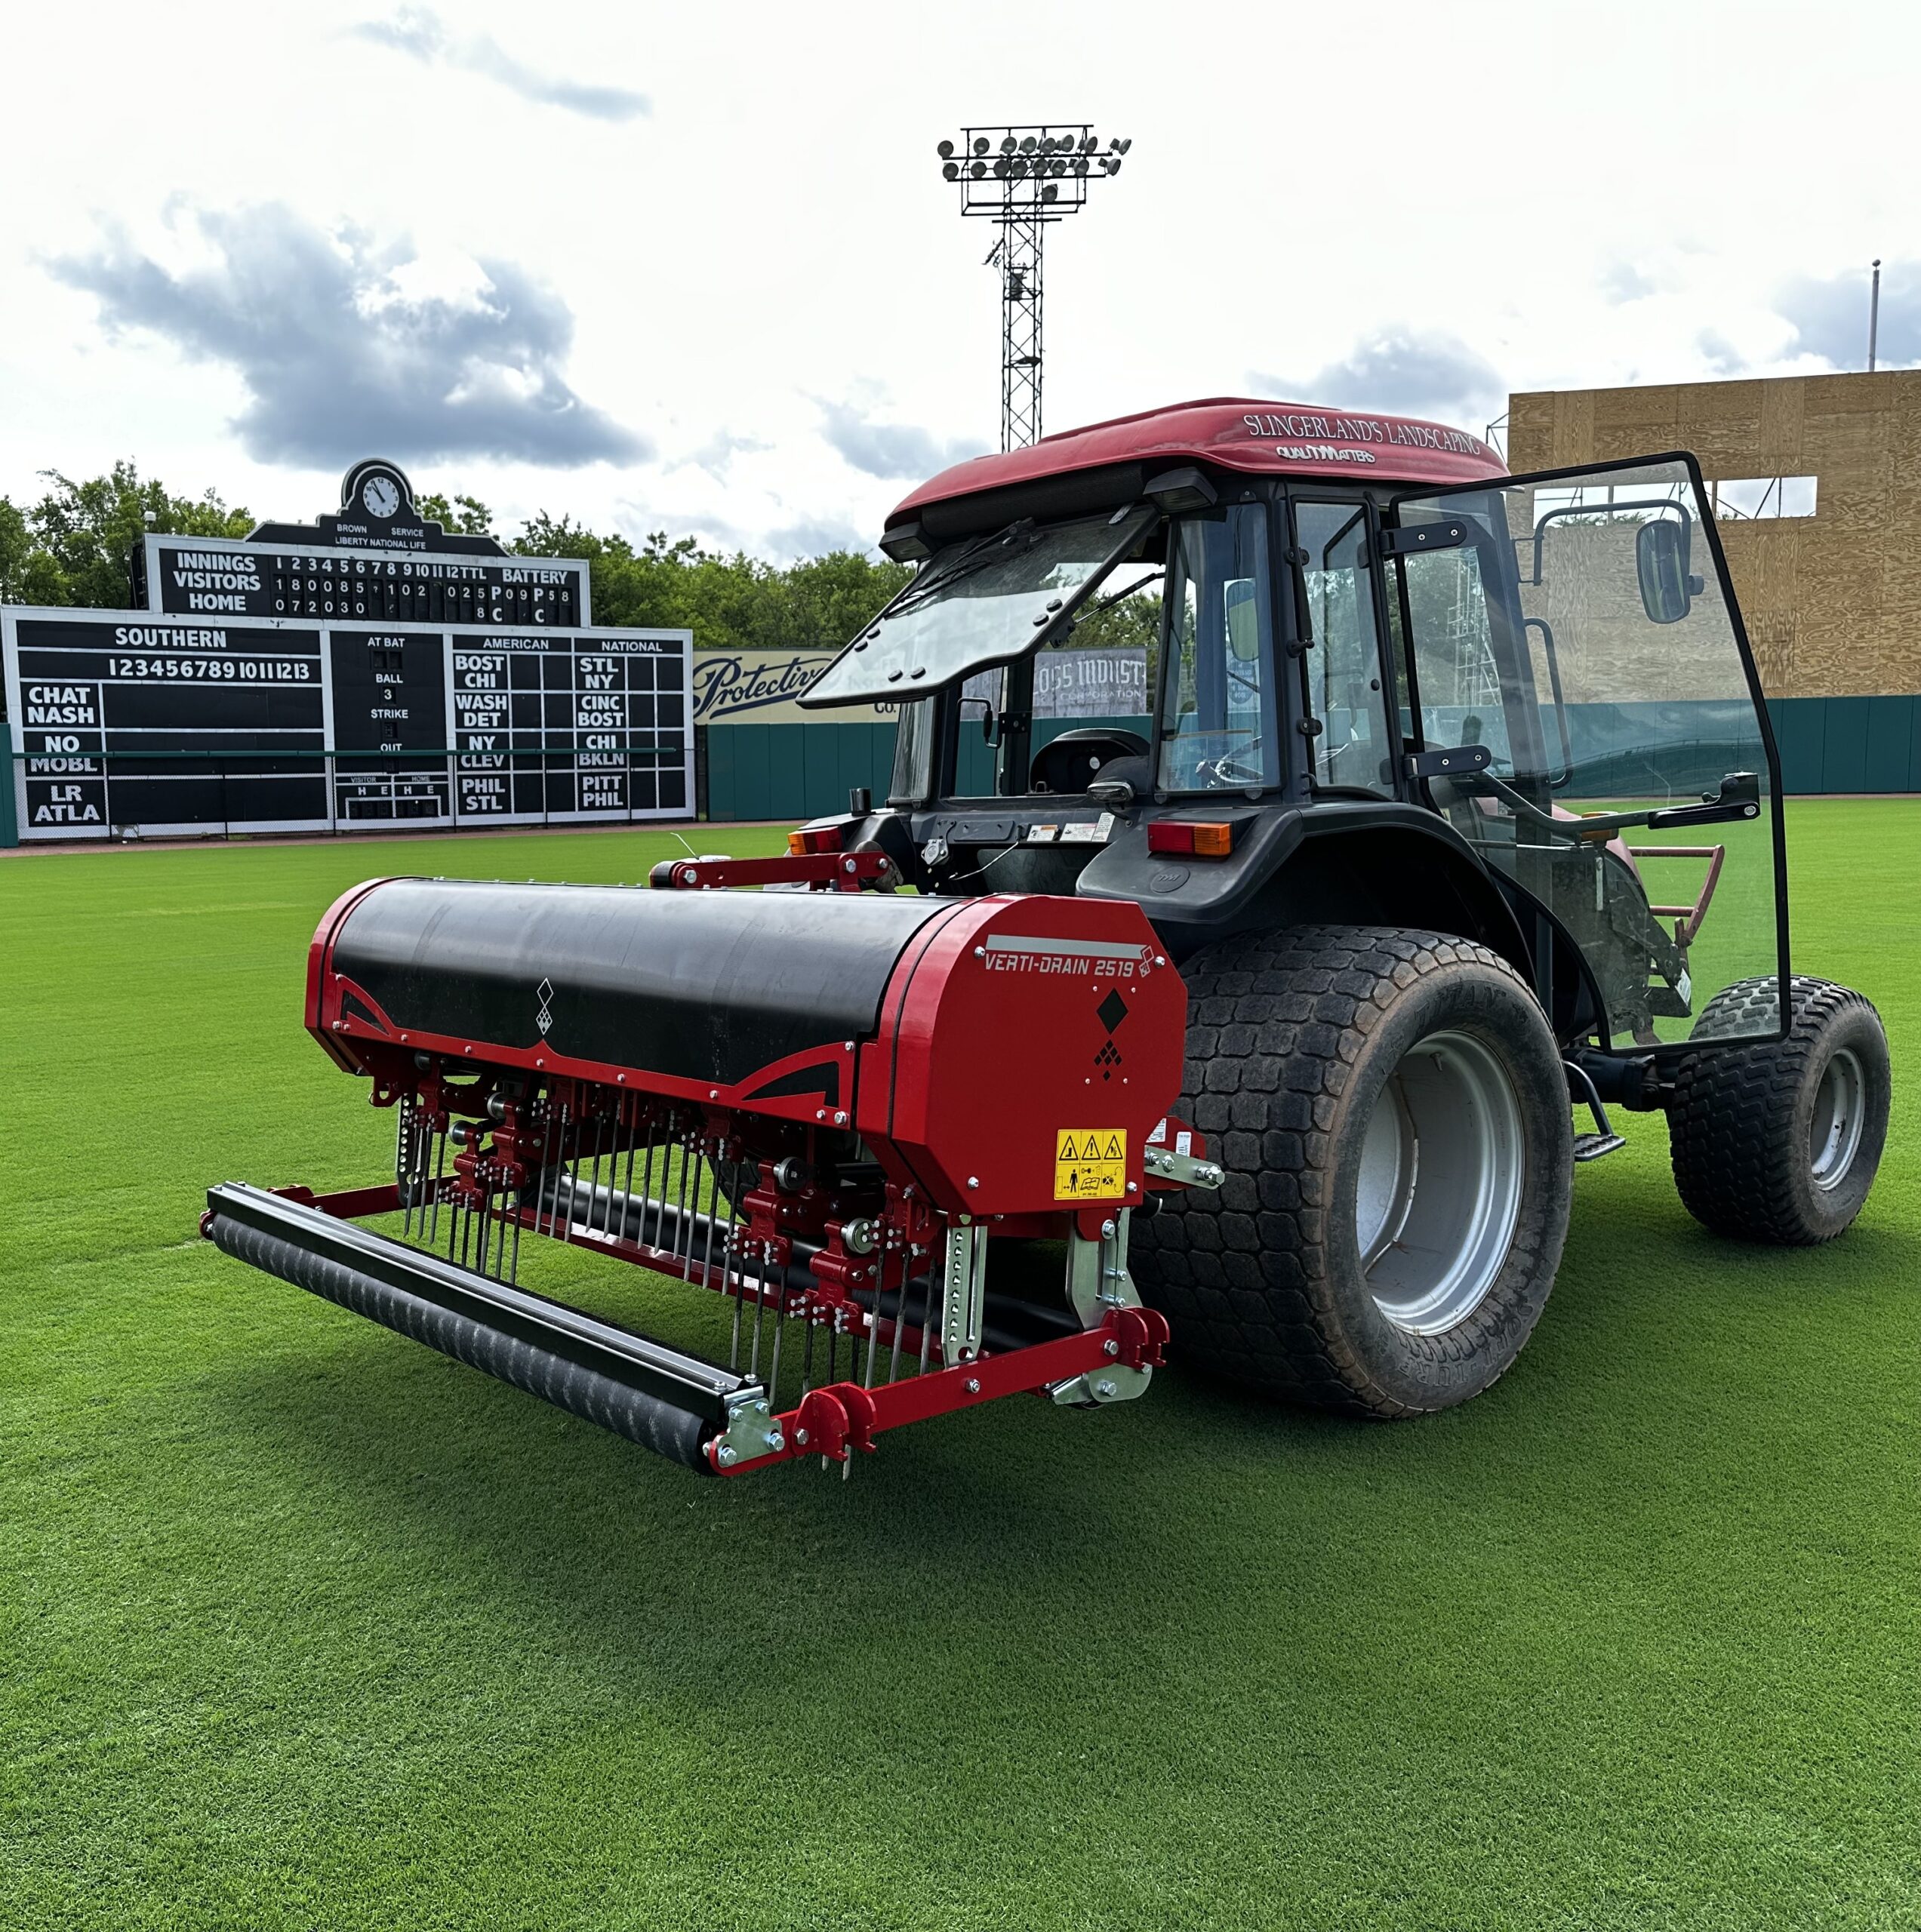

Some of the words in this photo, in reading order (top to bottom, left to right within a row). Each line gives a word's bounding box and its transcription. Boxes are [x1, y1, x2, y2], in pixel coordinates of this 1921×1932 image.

[1243, 415, 1384, 442] SLINGERLAND'S
[1385, 422, 1480, 455] LANDSCAPING
[337, 524, 367, 534] BROWN
[392, 528, 423, 537] SERVICE
[335, 537, 368, 546] LIBERTY
[370, 539, 408, 548] NATIONAL
[410, 541, 426, 549] LIFE
[177, 552, 257, 572] INNINGS
[277, 557, 282, 569] 1
[292, 556, 300, 570] 2
[308, 557, 318, 571] 3
[322, 559, 332, 571] 4
[340, 560, 349, 573] 5
[356, 560, 365, 573] 6
[372, 561, 381, 574] 7
[386, 561, 397, 575] 8
[402, 562, 413, 576] 9
[417, 565, 429, 577] 10
[433, 565, 442, 577] 11
[447, 565, 459, 578] 12
[460, 566, 488, 580] TTL
[502, 568, 568, 584] BATTERY
[174, 571, 260, 591] VISITORS
[277, 579, 282, 589] 1
[292, 580, 300, 590] 8
[340, 581, 348, 592] 8
[356, 583, 364, 593] 5
[389, 584, 393, 595] 1
[418, 586, 425, 596] 2
[491, 586, 501, 600] P
[534, 588, 543, 601] P
[189, 593, 246, 611] HOME
[292, 601, 300, 611] 7
[309, 601, 316, 612] 2
[341, 602, 348, 613] 3
[477, 608, 485, 618] 8
[493, 608, 502, 621] C
[535, 609, 544, 623] C
[115, 626, 226, 648] SOUTHERN
[368, 637, 381, 646] AT
[384, 638, 405, 648] BAT
[482, 637, 550, 651] AMERICAN
[601, 641, 662, 652] NATIONAL
[456, 654, 505, 671] BOST
[580, 657, 620, 672] STL
[376, 674, 403, 683] BALL
[464, 673, 497, 689] CHI
[584, 675, 614, 690] NY
[1033, 662, 1073, 694] OSS
[29, 687, 90, 703] CHAT
[384, 689, 392, 700] 3
[693, 657, 832, 719] Protectiv
[454, 694, 508, 711] WASH
[582, 694, 620, 709] CINC
[28, 706, 94, 723] NASH
[371, 709, 408, 718] STRIKE
[463, 712, 502, 728] DET
[578, 711, 625, 726] BOST
[45, 736, 79, 752] NO
[469, 736, 495, 750] NY
[586, 735, 616, 749] CHI
[31, 758, 97, 772] MOBL
[461, 755, 503, 768] CLEV
[580, 753, 624, 765] BKLN
[381, 786, 387, 795] E
[404, 786, 411, 795] H
[426, 786, 435, 795] E
[463, 779, 505, 793] PHIL
[583, 776, 622, 790] PITT
[51, 786, 82, 801] LR
[583, 792, 623, 807] PHIL
[466, 795, 502, 810] STL
[35, 804, 100, 821] ATLA
[984, 953, 1090, 975] VERTI-DRAIN
[1094, 959, 1134, 977] 2519
